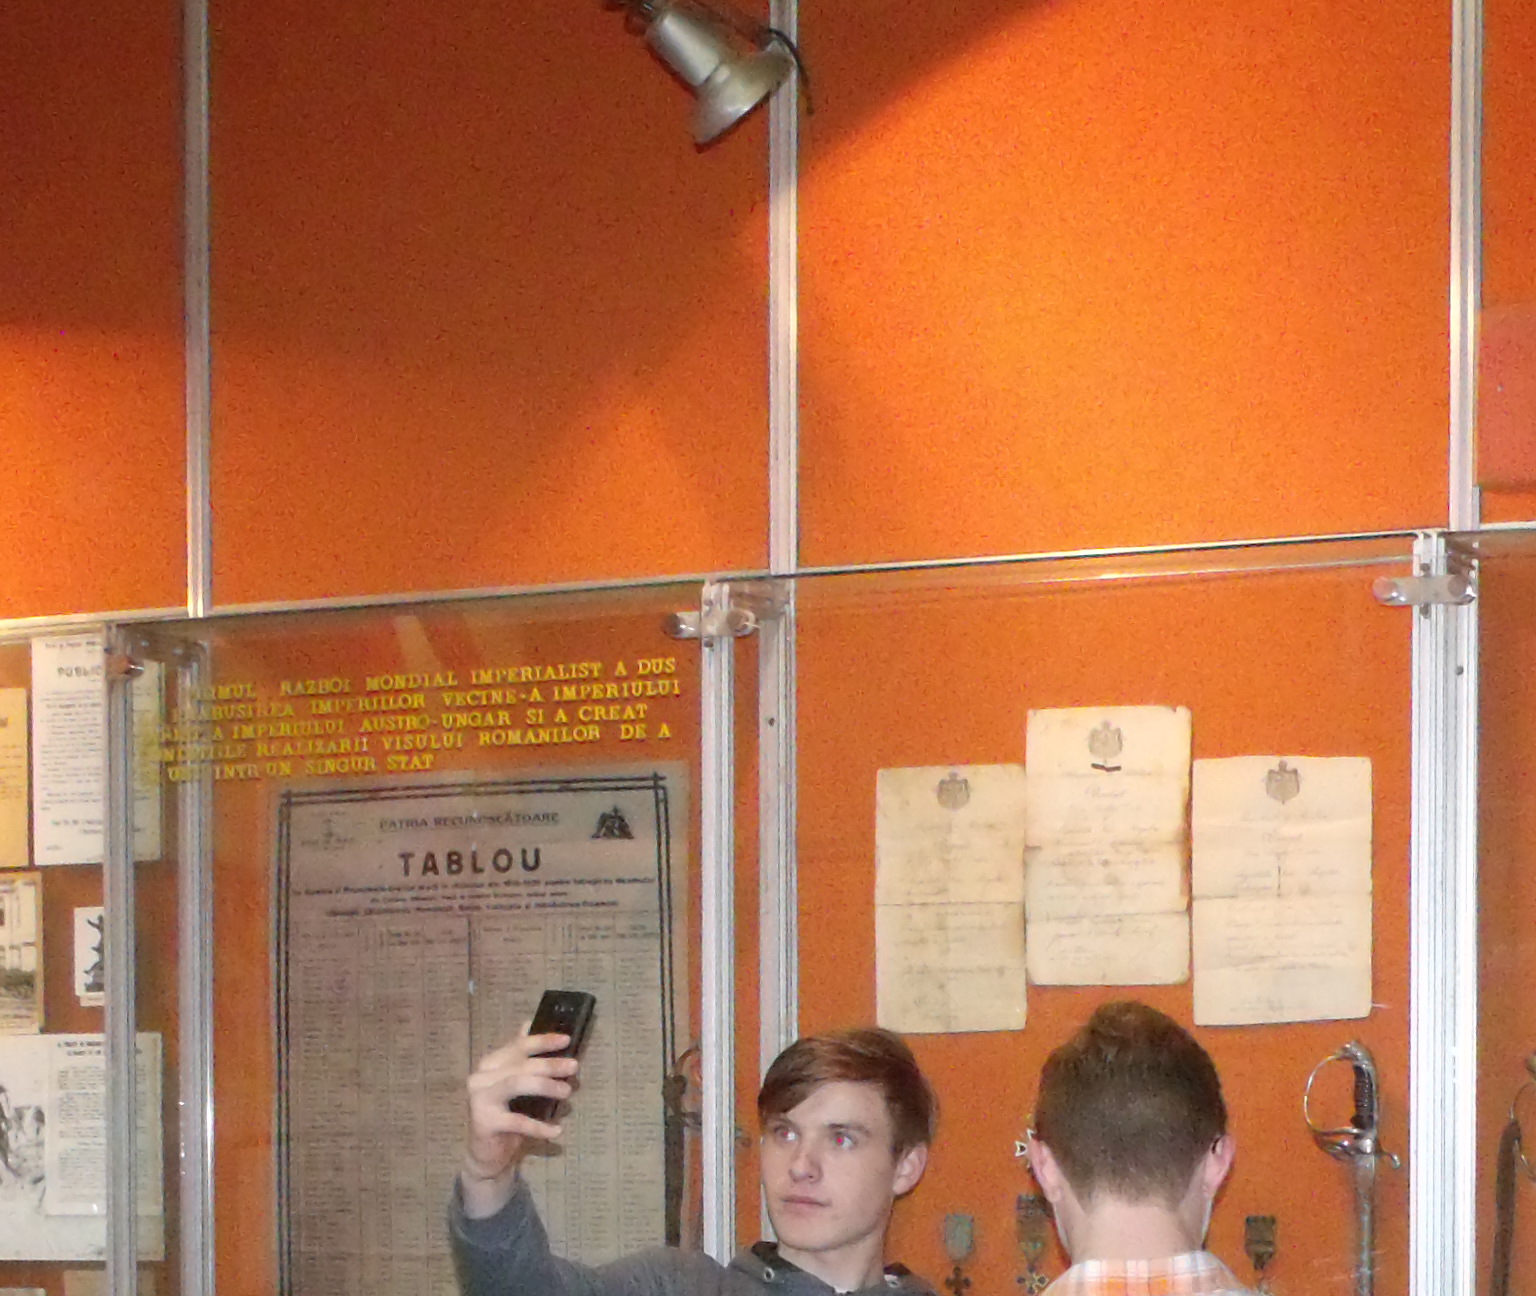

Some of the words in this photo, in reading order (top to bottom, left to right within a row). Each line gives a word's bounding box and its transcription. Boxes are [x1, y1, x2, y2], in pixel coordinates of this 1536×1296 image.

[279, 678, 352, 697] RAZBOI
[365, 671, 458, 692] MONDIAL
[471, 661, 603, 685] IMPERIALIST
[615, 661, 628, 676] A
[637, 657, 677, 675] DUS
[553, 679, 681, 701] IMPERIULUI
[359, 711, 512, 733] AUSTRO-UNGAR
[525, 709, 544, 725] SI
[554, 708, 568, 723] A
[578, 703, 649, 722] CREAT
[382, 732, 463, 751] VISULUI
[478, 725, 601, 746] ROMANILOR
[620, 723, 647, 740] DE
[657, 723, 672, 738] A
[305, 756, 378, 775] SINGUR
[386, 754, 434, 770] STAT
[398, 847, 542, 877] TABLOU
